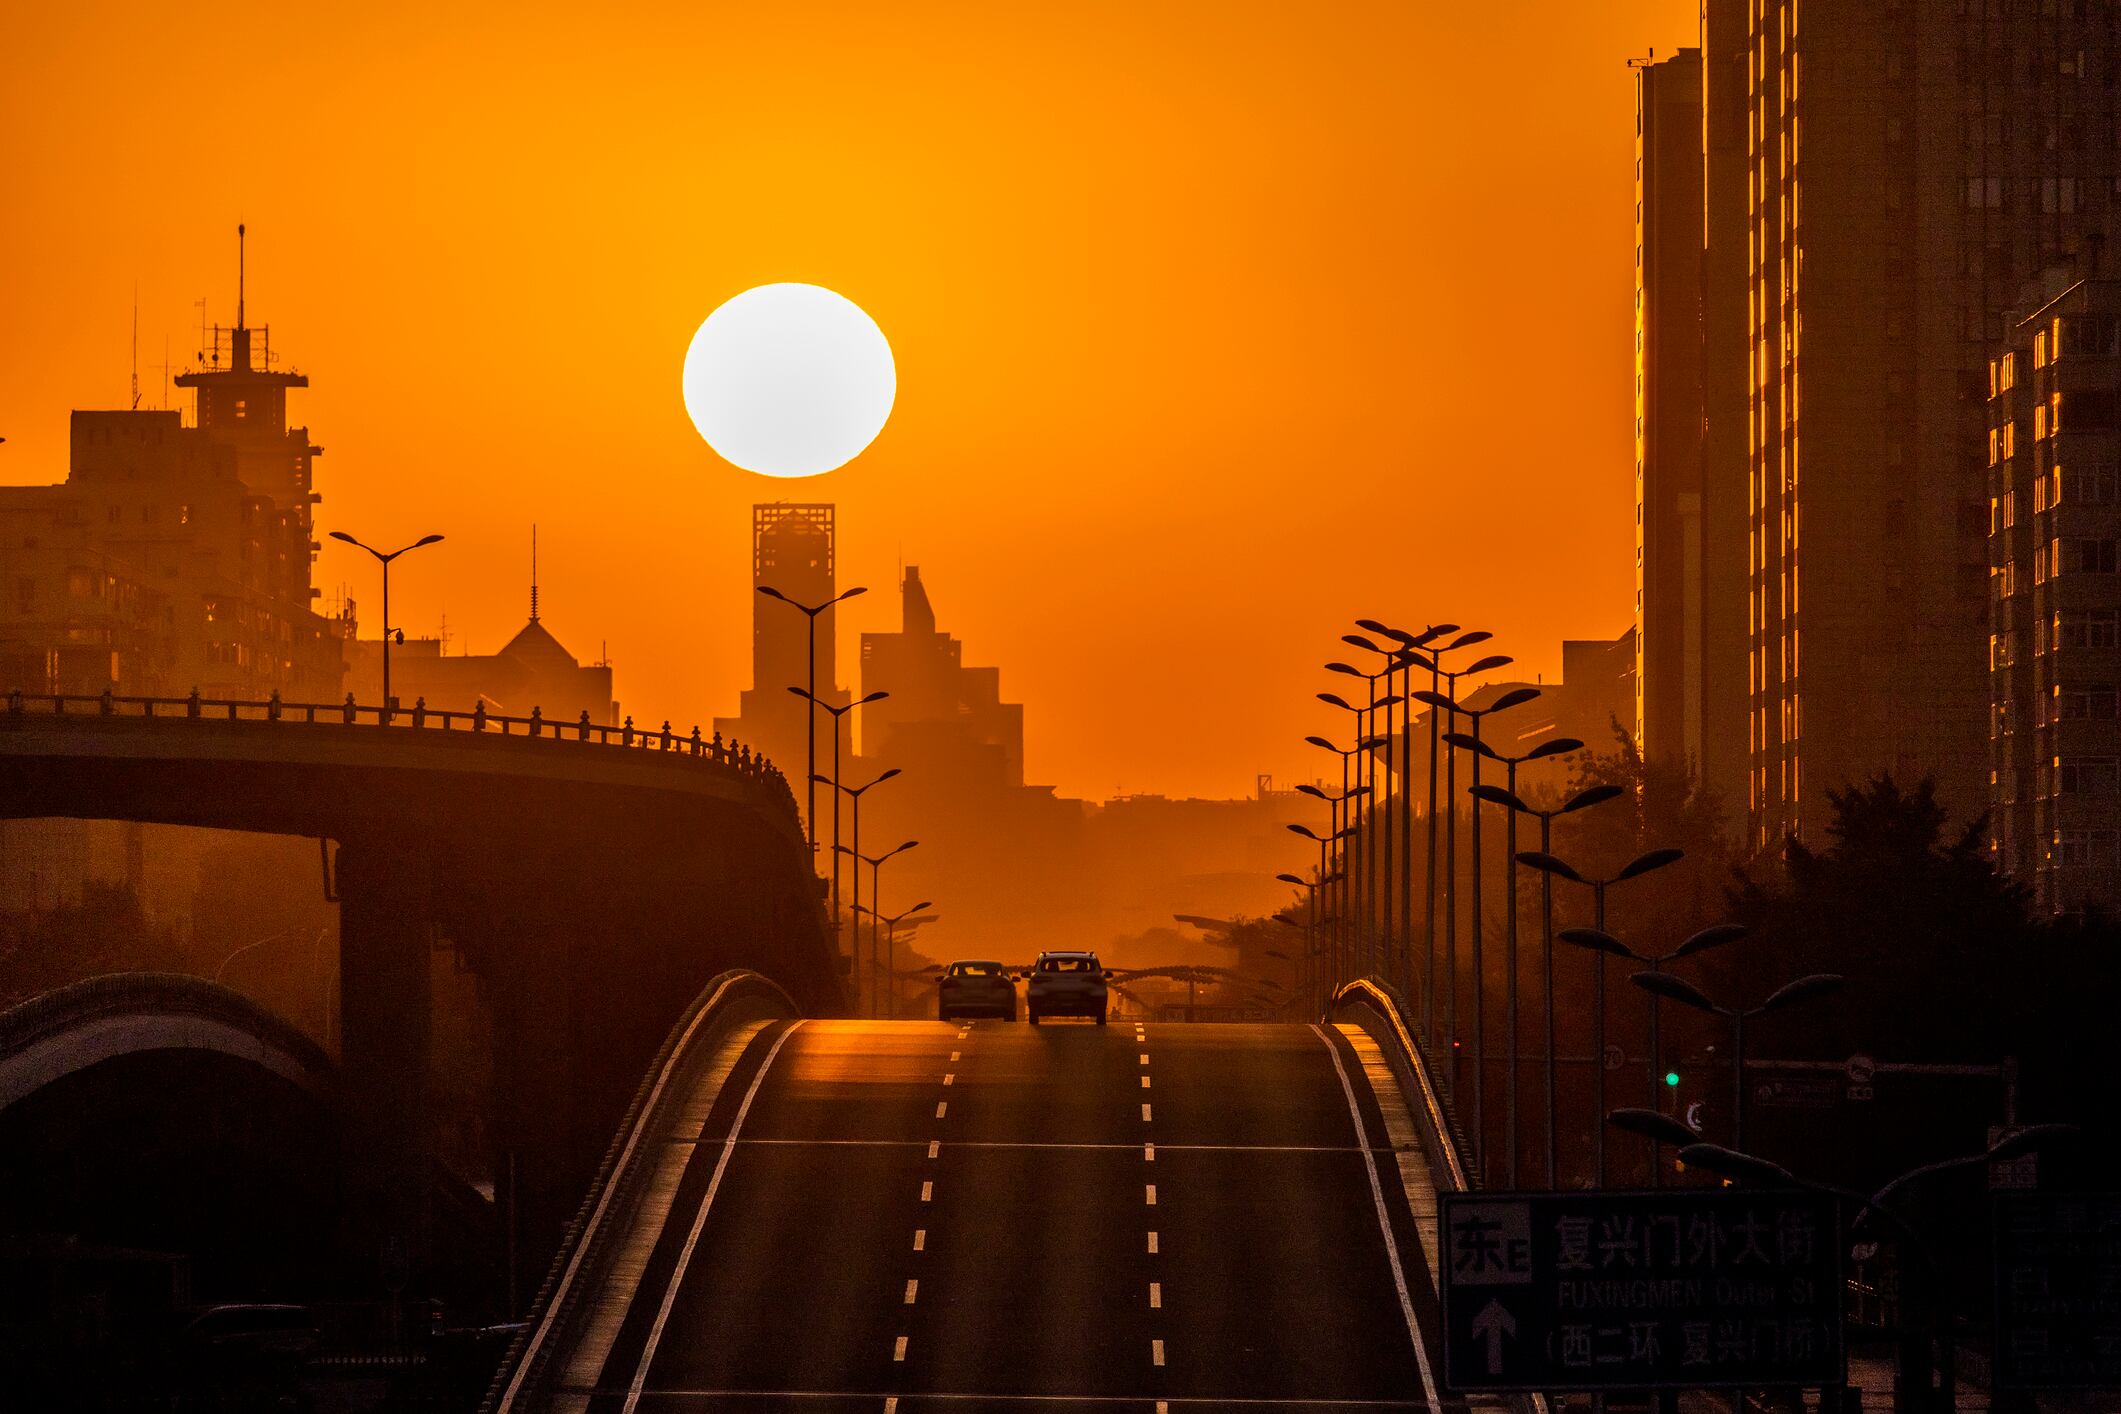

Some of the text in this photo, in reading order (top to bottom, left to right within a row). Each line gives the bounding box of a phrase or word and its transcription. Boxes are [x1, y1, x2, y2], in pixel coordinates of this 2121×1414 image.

[1454, 1215, 1505, 1274] 东
[1507, 1239, 1530, 1273] E
[1554, 1208, 1817, 1271] 复兴门外大街
[1557, 1278, 1703, 1310] FUXINGMEN
